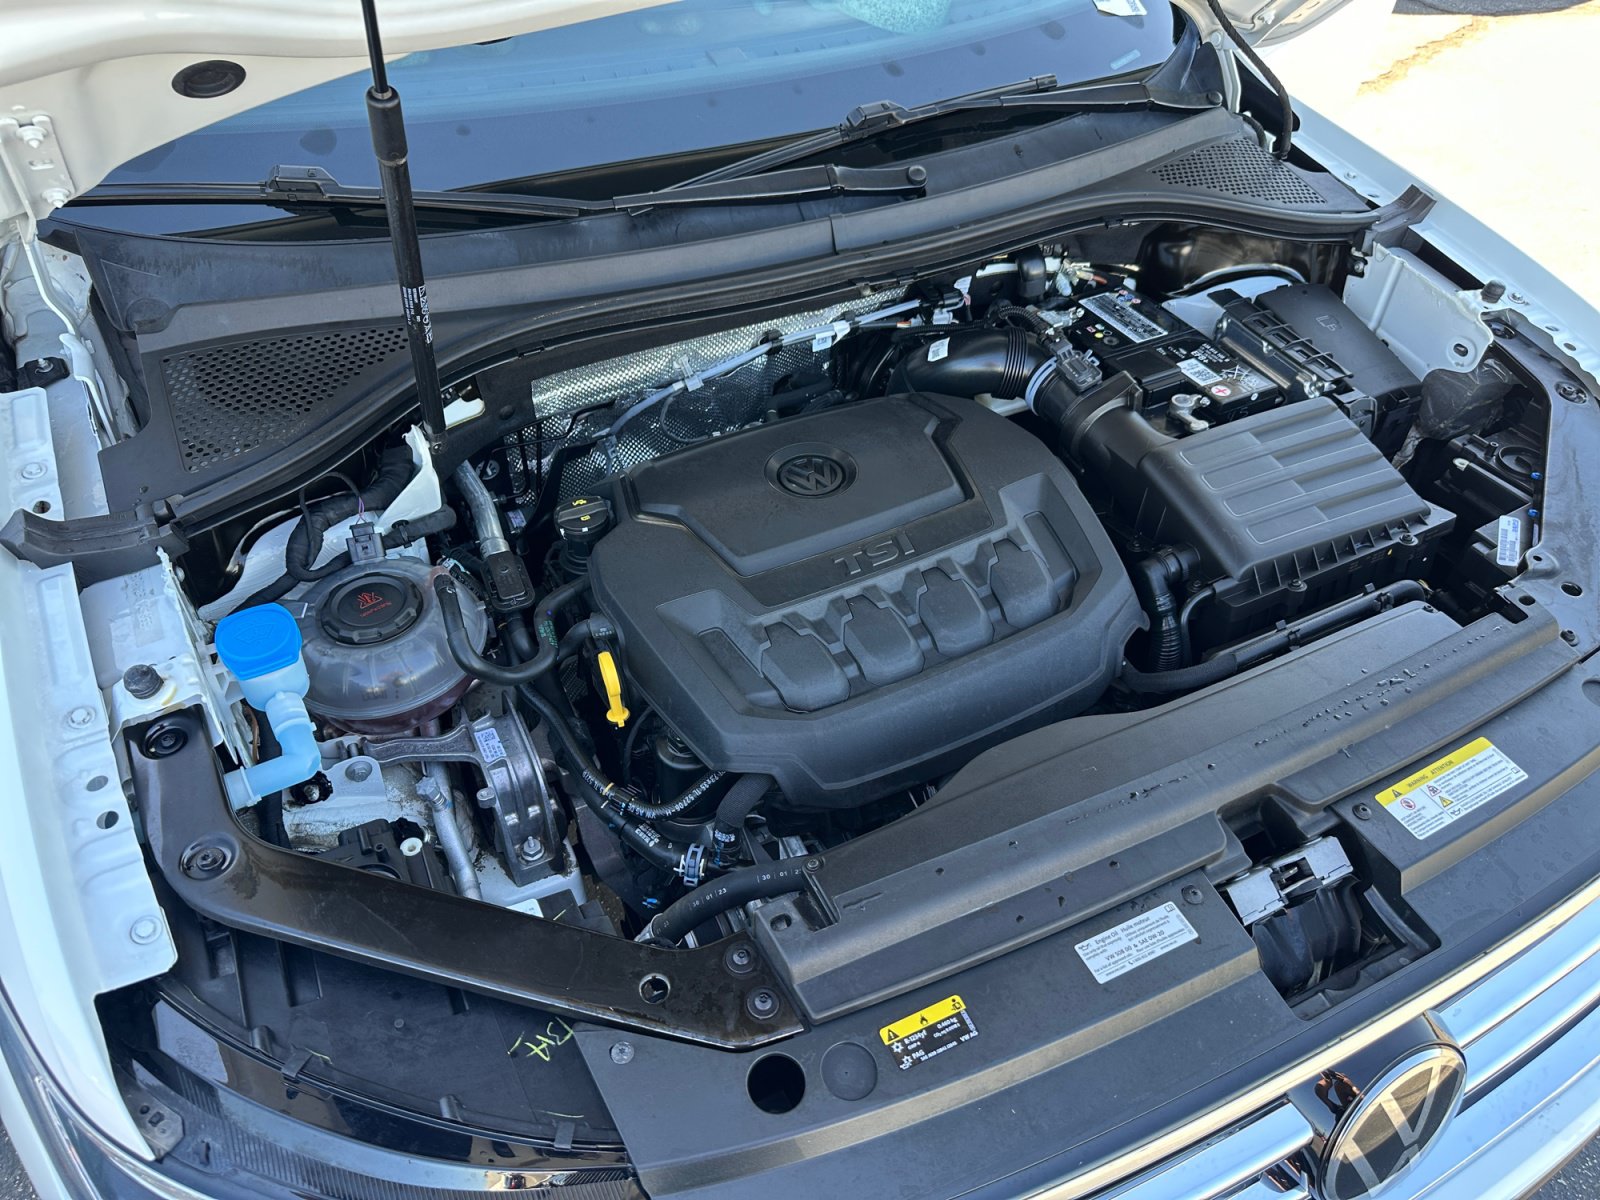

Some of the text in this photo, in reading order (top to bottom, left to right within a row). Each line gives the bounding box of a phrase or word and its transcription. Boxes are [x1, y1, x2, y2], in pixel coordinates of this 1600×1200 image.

[832, 530, 916, 576] TSI
[1407, 759, 1453, 787] WARNING ATTENTION
[706, 893, 713, 901] 01
[1120, 916, 1150, 932] Huile moteur
[1094, 934, 1111, 945] Engine
[903, 1030, 928, 1045] R-1234yf
[911, 1049, 924, 1058] PAG
